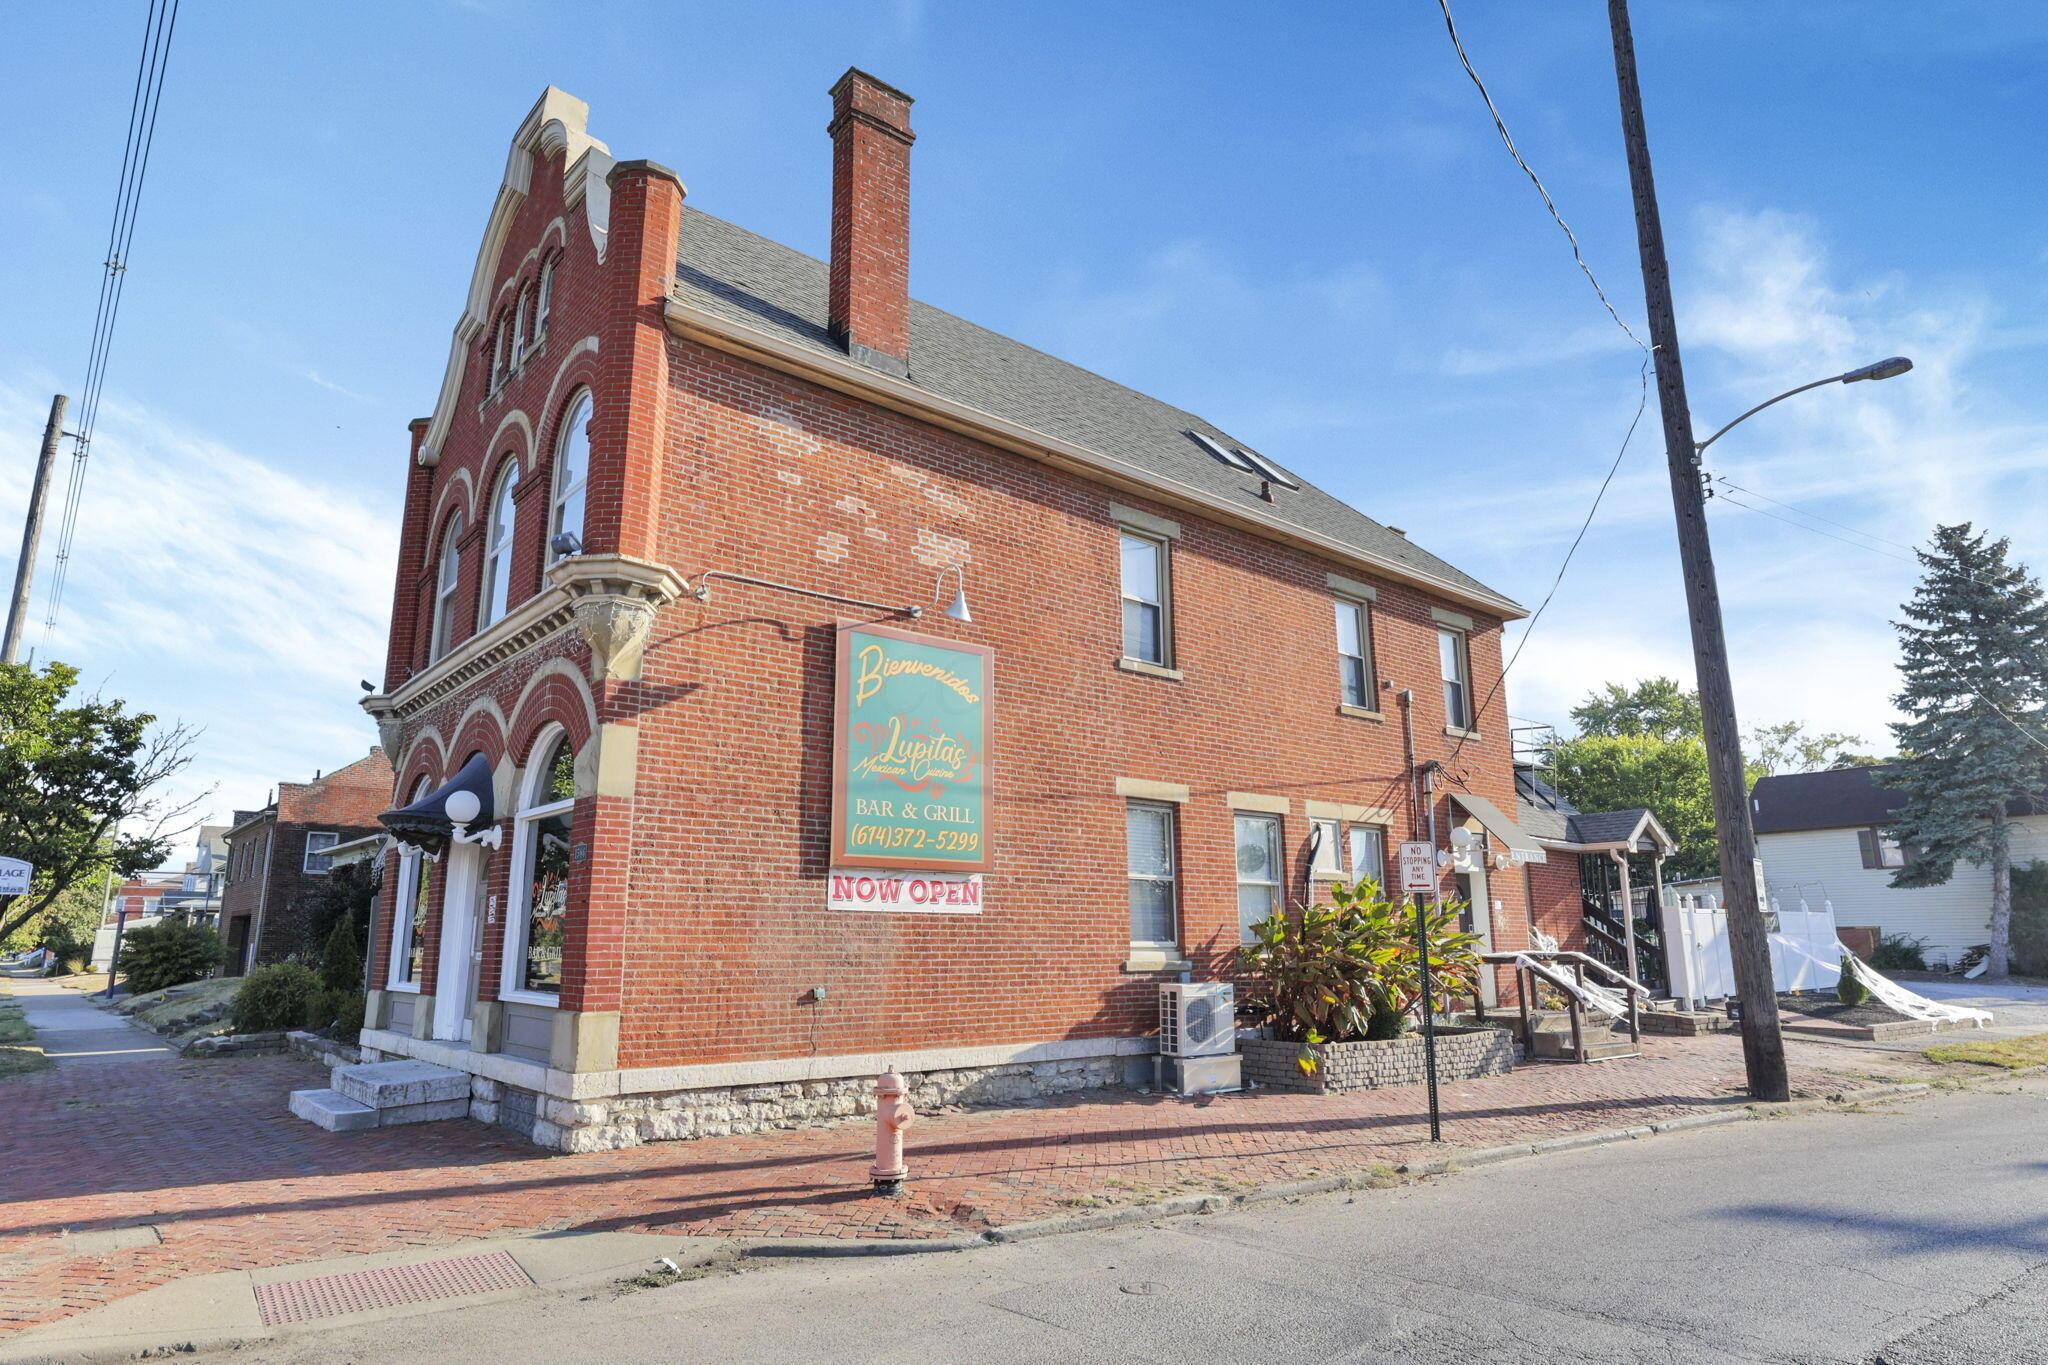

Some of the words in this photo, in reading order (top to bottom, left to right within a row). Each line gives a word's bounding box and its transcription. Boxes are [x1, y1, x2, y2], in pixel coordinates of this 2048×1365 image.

[856, 644, 980, 707] Bienvenidos
[853, 757, 908, 779] Mexican
[913, 759, 955, 781] Cuisine
[855, 799, 895, 818] BAR
[902, 803, 919, 820] &
[923, 804, 976, 824] GRILL
[851, 823, 979, 852] (614)372-5299
[1402, 857, 1432, 866] STOPPING
[1410, 847, 1422, 856] NO
[832, 875, 903, 904] NOW
[908, 879, 981, 905] OPEN
